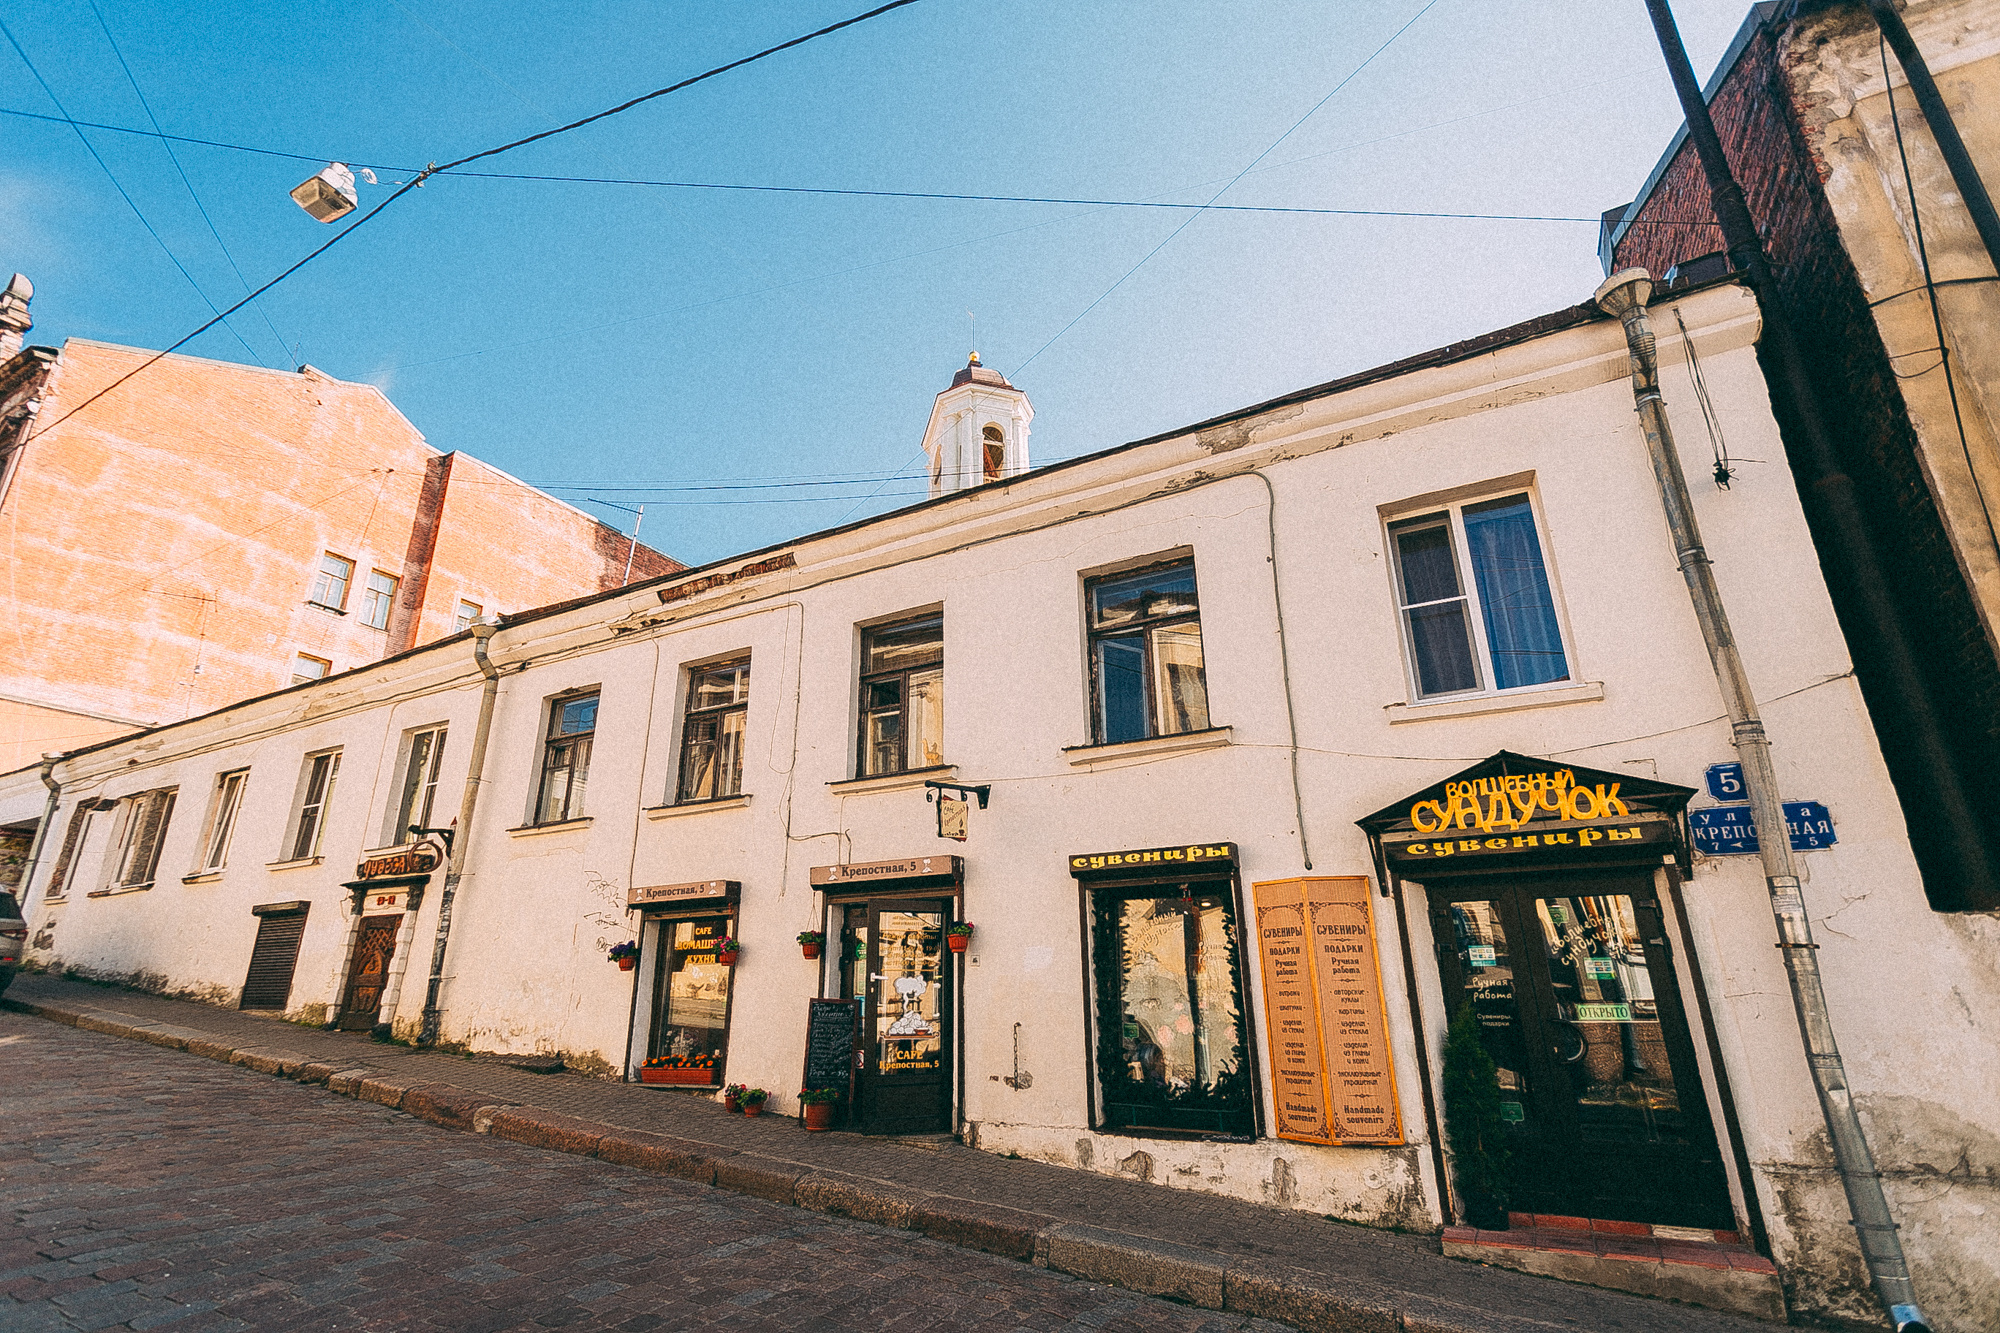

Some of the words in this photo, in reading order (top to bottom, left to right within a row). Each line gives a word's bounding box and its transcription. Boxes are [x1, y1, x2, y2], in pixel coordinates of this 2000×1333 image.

[1446, 768, 1575, 800] ВОЛШЕБНЫЙ
[1719, 772, 1741, 793] 5
[1410, 783, 1630, 833] СУНДУЧОК
[1699, 807, 1812, 825] ула
[1694, 819, 1831, 841] КРЕПОНАЯ
[1406, 827, 1643, 857] сувениры
[1711, 842, 1720, 851] 7
[1808, 836, 1819, 847] 5
[1072, 845, 1230, 869] сувениры
[841, 864, 908, 879] Крепостная,
[910, 862, 917, 871] 5
[646, 886, 698, 899] Крепостная,
[699, 884, 705, 893] 5
[695, 927, 713, 935] CAFE
[1263, 926, 1303, 938] СУВЕНИРЫ
[1316, 924, 1366, 935] СУВЕНИРЫ
[1269, 946, 1301, 955] ПОДАРКИ
[1324, 944, 1364, 953] ПОДАРКИ
[687, 954, 716, 964] КУХНЯ
[1275, 959, 1297, 968] Ручная
[1331, 957, 1359, 966] Ручная
[1276, 968, 1298, 977] работа
[1332, 966, 1360, 975] работа
[1472, 977, 1508, 991] Ручная
[1473, 989, 1512, 1002] работа
[1579, 1006, 1629, 1018] ОТКРЫТО
[896, 1050, 924, 1060] CAFE
[879, 1060, 933, 1071] Крепостная,
[934, 1060, 940, 1068] 5
[1285, 1102, 1317, 1113] Handmade
[1344, 1105, 1384, 1114] Handmade
[1287, 1113, 1317, 1123] souvenirs
[1346, 1115, 1384, 1124] souvenirs
